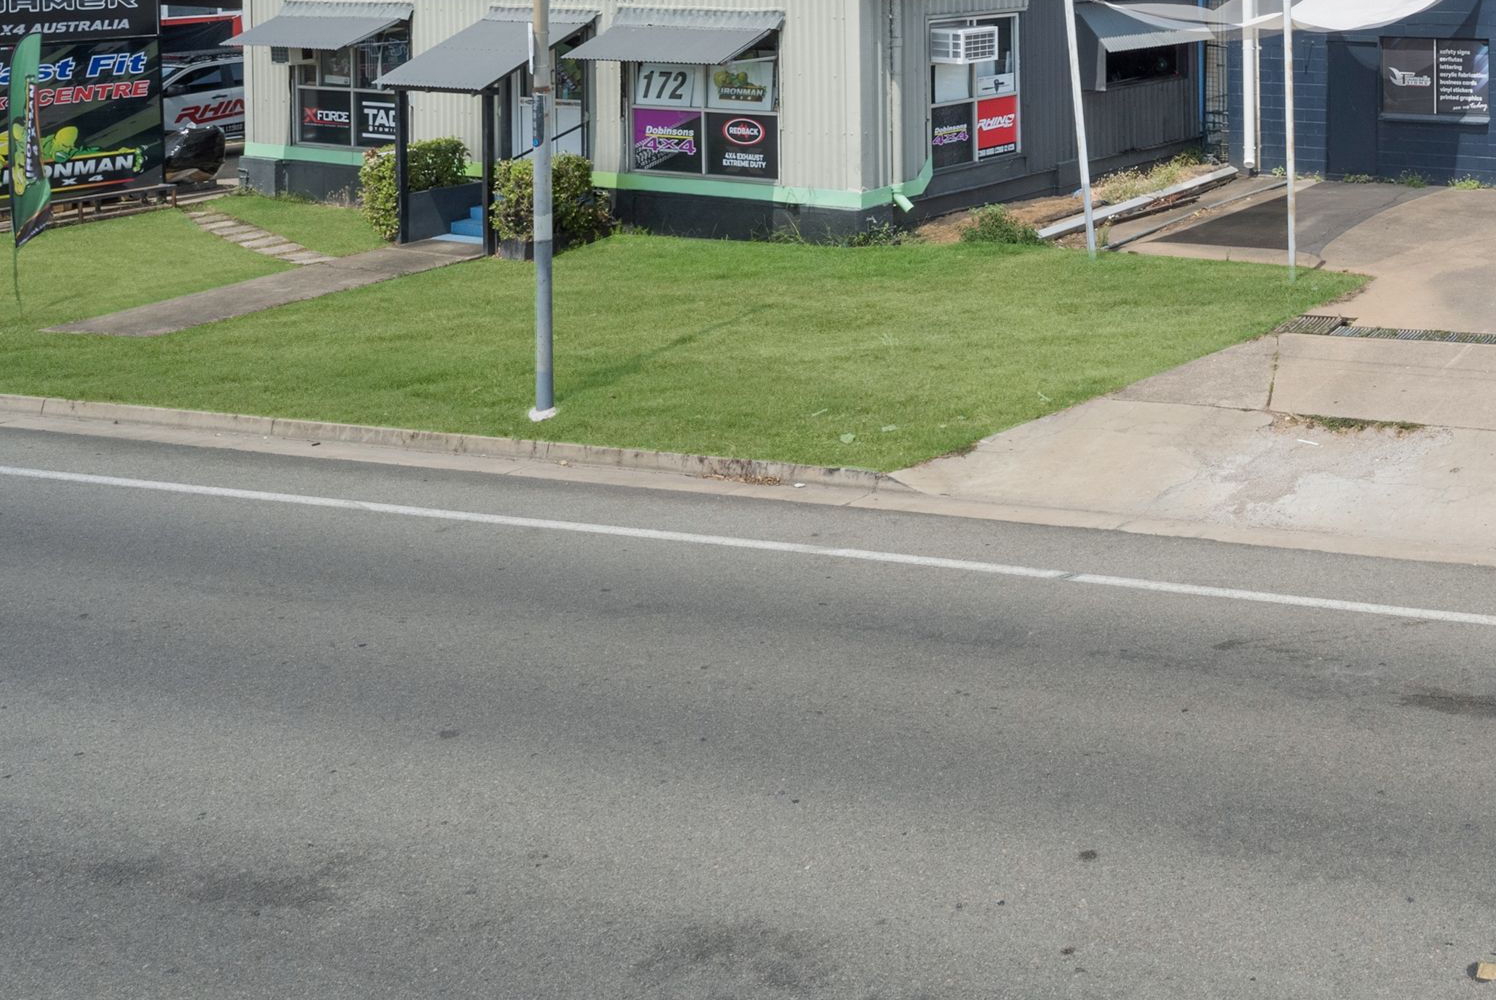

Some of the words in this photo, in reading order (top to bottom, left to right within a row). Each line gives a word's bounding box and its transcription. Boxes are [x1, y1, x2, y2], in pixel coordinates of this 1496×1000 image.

[0, 23, 26, 36] X4
[30, 19, 130, 34] AUSTRALIA
[86, 51, 148, 79] Fit
[38, 80, 150, 107] CENTRE
[642, 70, 688, 101] 172
[720, 87, 764, 97] IRONMAN
[174, 98, 245, 125] RHIN
[645, 125, 695, 137] Dobinsons
[728, 126, 759, 136] REDBACK
[722, 158, 750, 167] EXTREME
[749, 160, 766, 169] DUTY
[736, 153, 764, 161] EXHAUST
[3, 154, 134, 186] INMAN
